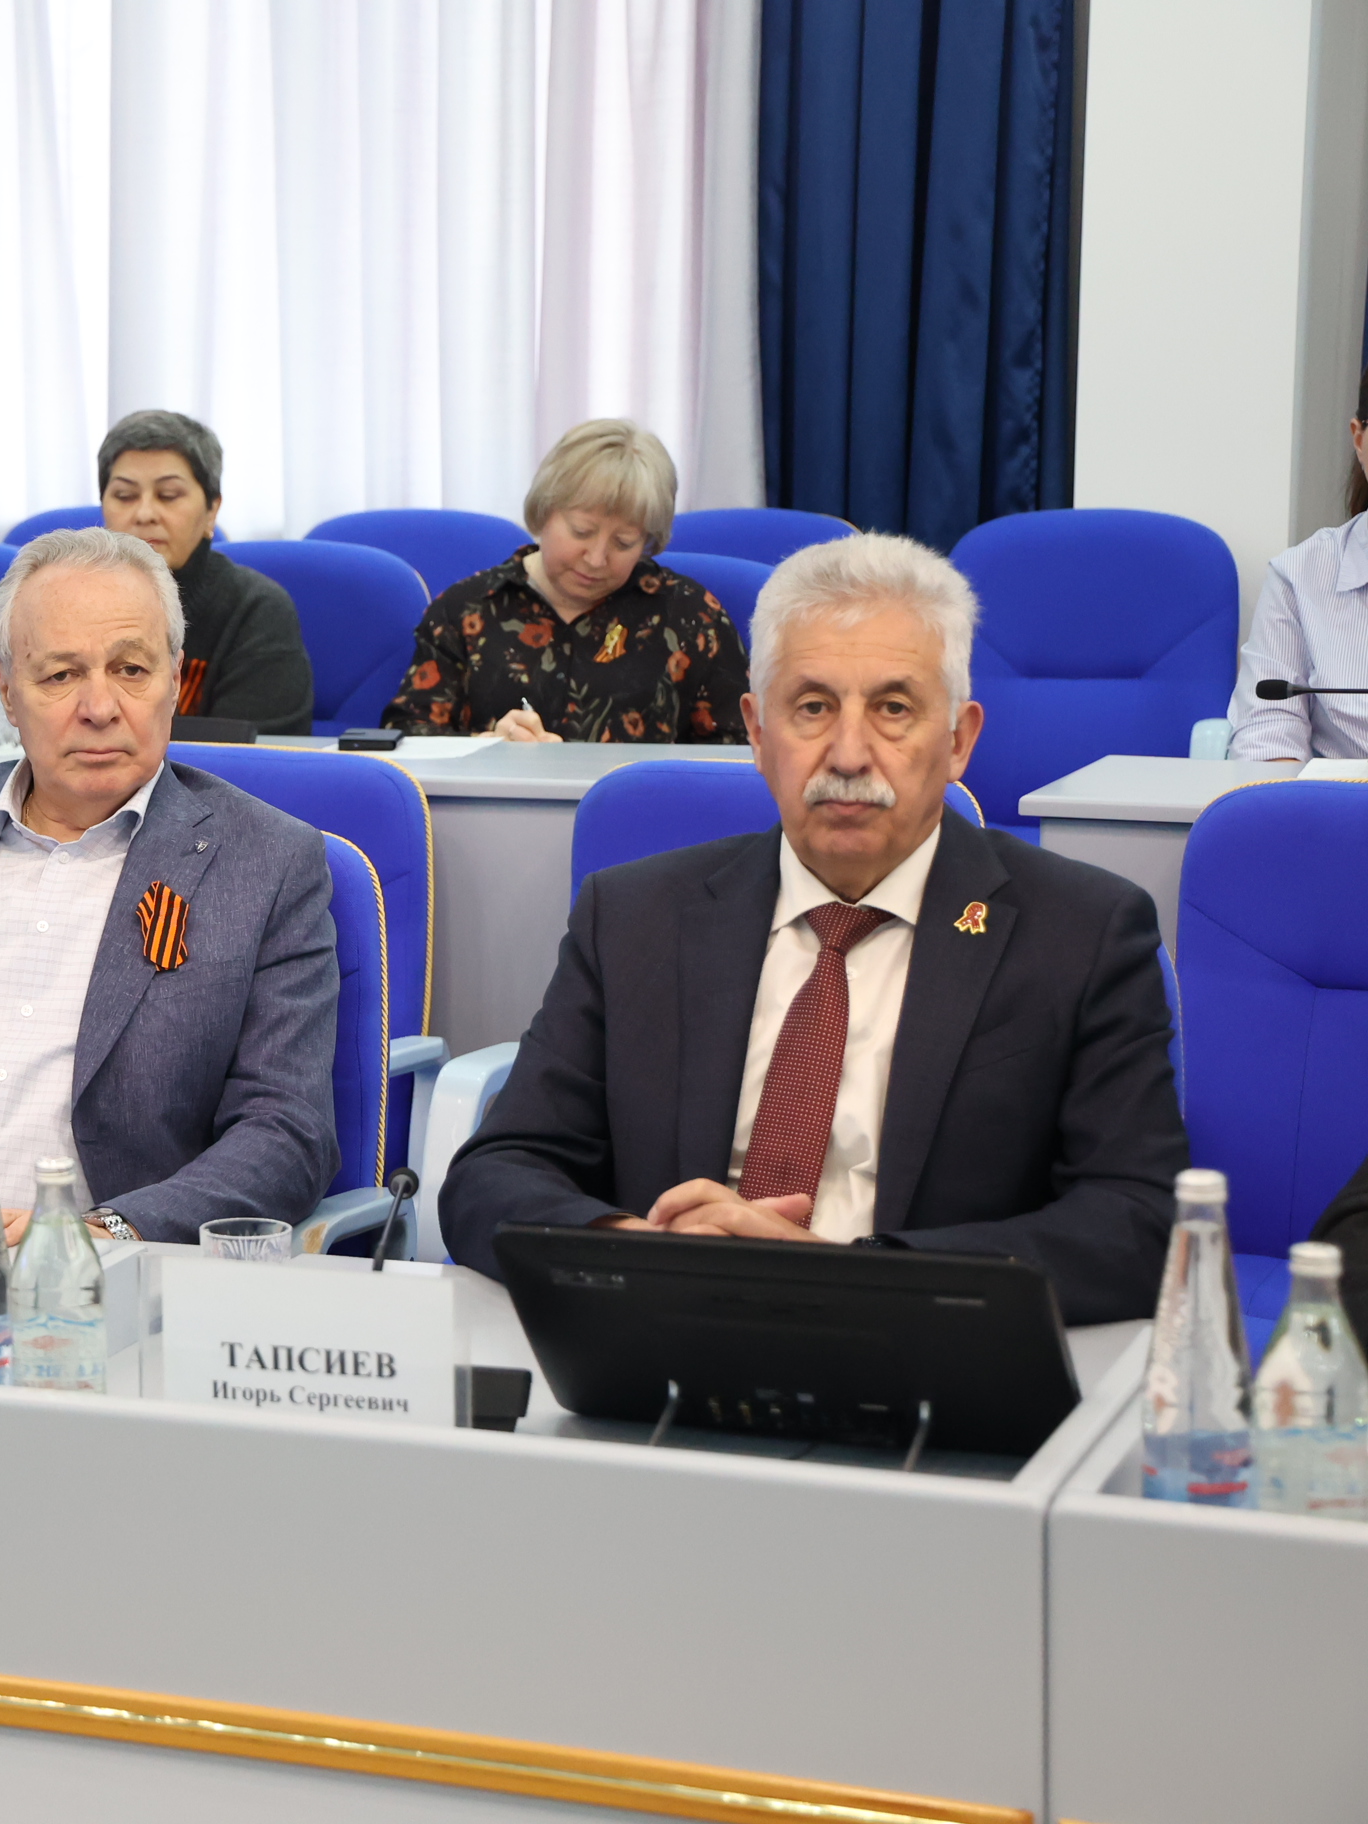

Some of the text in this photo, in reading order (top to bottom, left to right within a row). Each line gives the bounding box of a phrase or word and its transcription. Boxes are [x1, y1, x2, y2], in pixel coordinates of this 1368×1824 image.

[220, 1341, 398, 1380] ТАПСИЕВ
[211, 1380, 410, 1413] Игорь Сергеевич
